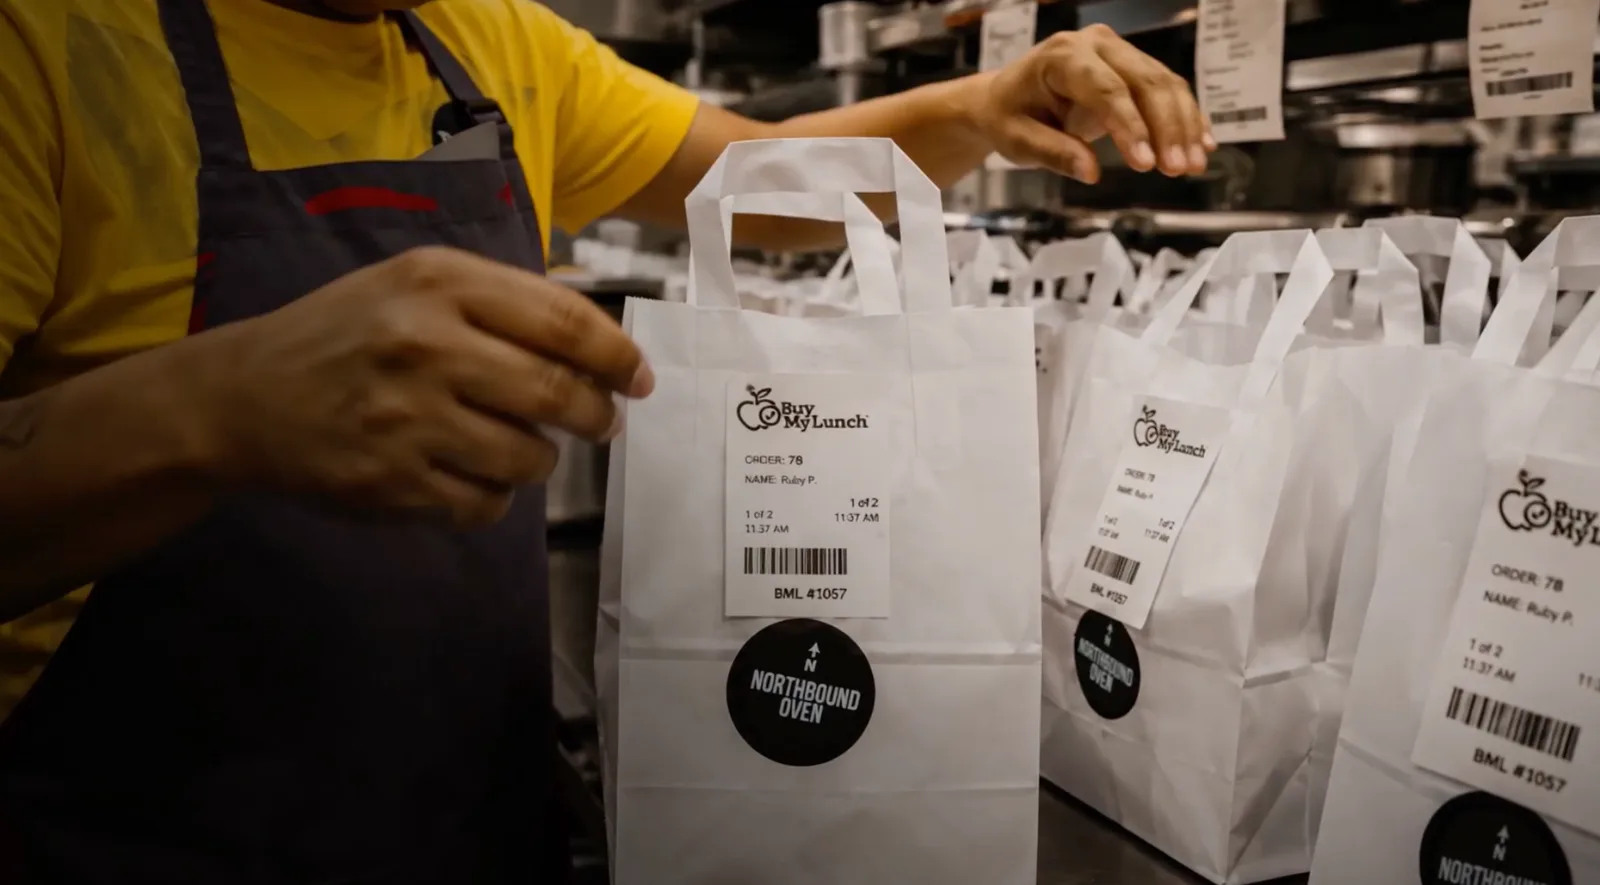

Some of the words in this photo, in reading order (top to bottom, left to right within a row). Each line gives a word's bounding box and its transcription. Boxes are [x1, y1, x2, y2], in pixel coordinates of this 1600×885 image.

[781, 402, 815, 417] Buy
[788, 455, 803, 465] 78
[745, 475, 777, 484] NAME:
[781, 475, 806, 486] Ruby
[871, 498, 879, 508] 2
[754, 510, 764, 519] of
[767, 510, 773, 519] 2
[863, 513, 879, 523] AM
[1553, 500, 1598, 527] Buy
[773, 524, 789, 534] AM
[774, 588, 803, 600] BML
[804, 658, 817, 673] N
[750, 669, 861, 711] NORTHBOUND
[779, 697, 823, 724] OVEN
[1473, 748, 1508, 774] BML
[1492, 843, 1507, 861] N
